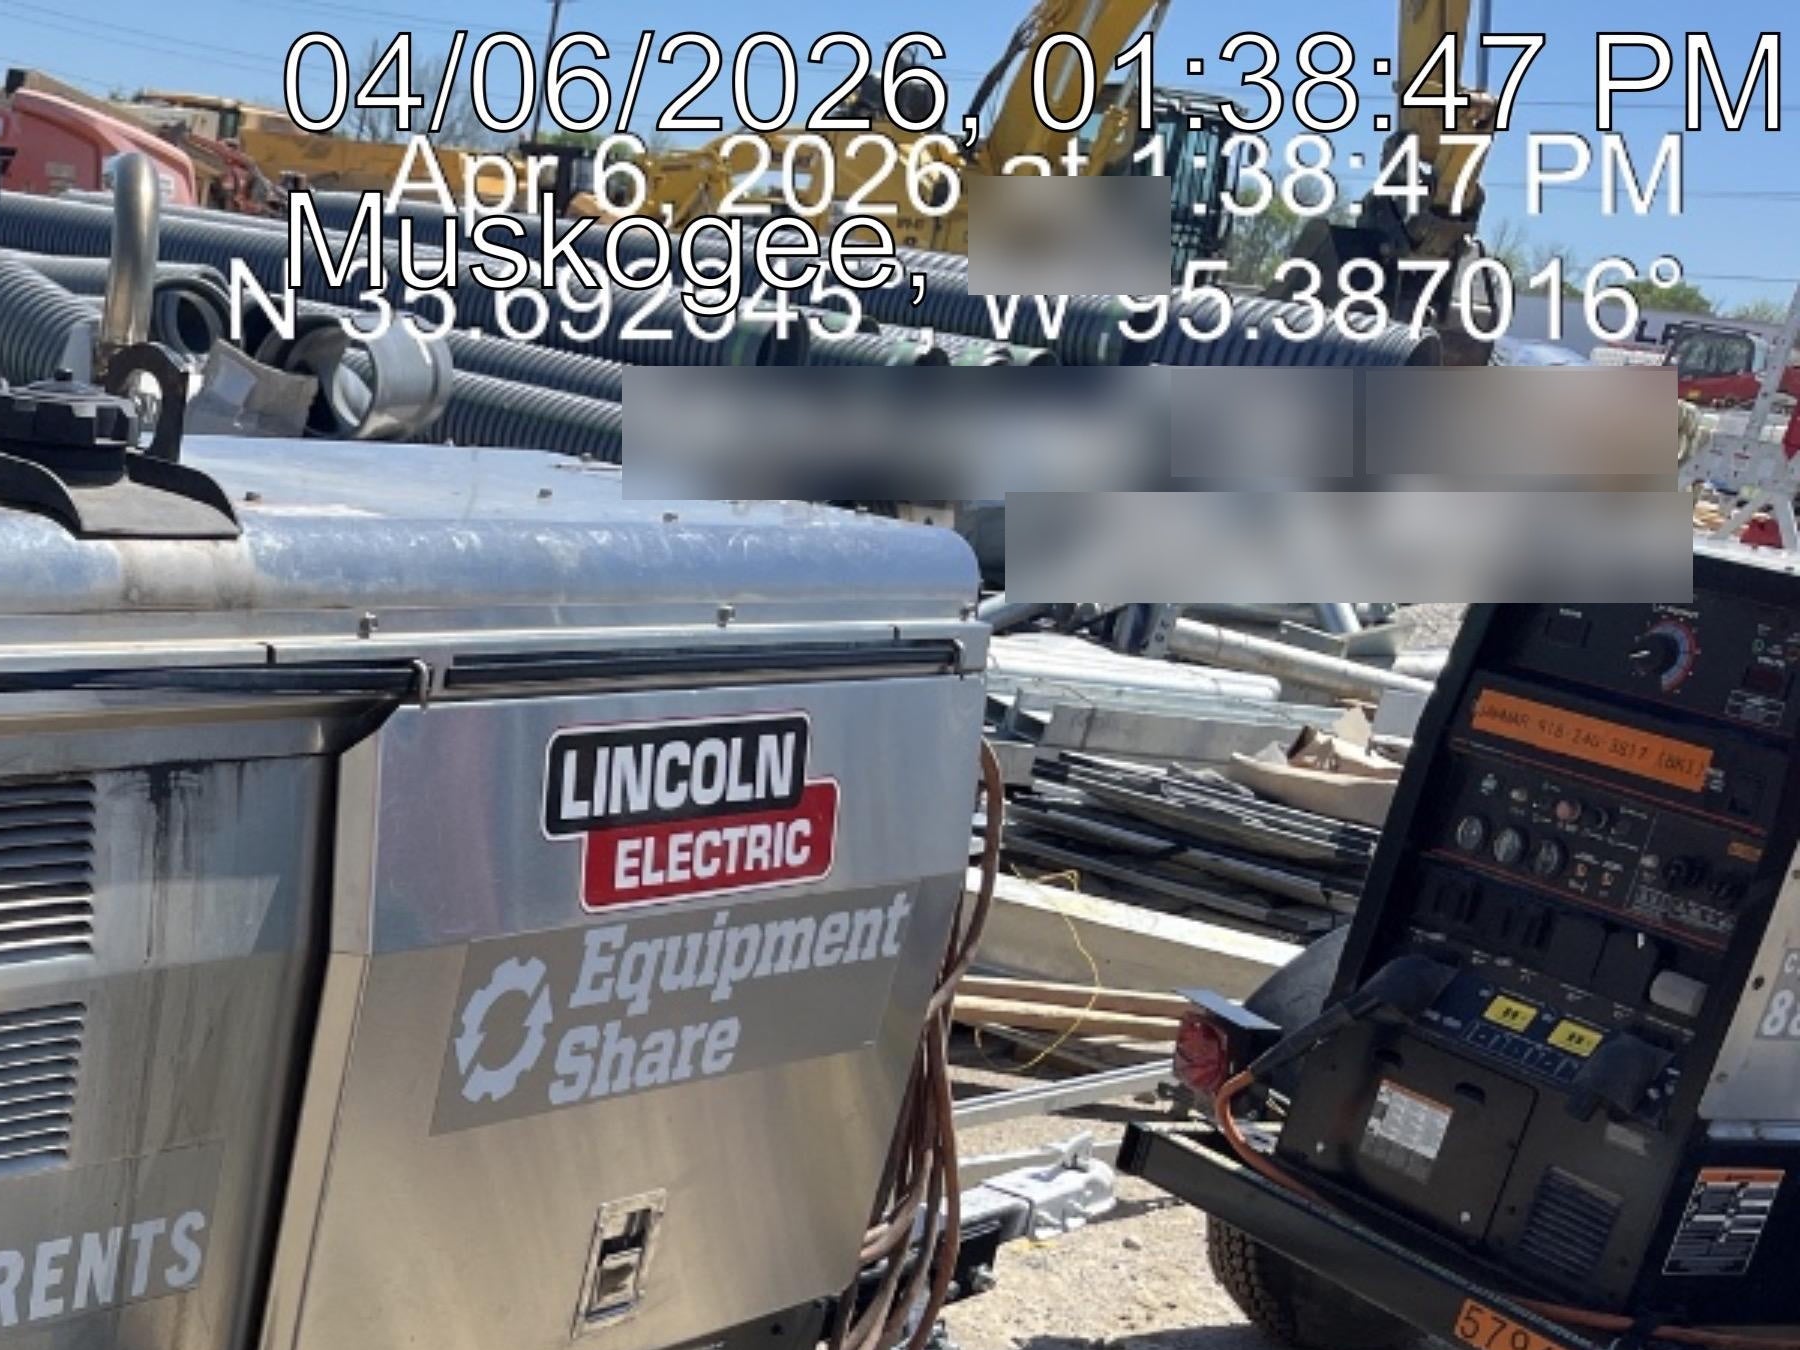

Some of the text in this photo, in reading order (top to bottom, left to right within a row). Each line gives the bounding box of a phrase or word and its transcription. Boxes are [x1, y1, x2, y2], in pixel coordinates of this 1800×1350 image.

[560, 731, 797, 821] LINCOLN
[613, 818, 812, 890] ELECTRIC
[568, 892, 912, 1018] Equipment
[547, 1014, 741, 1106] Share
